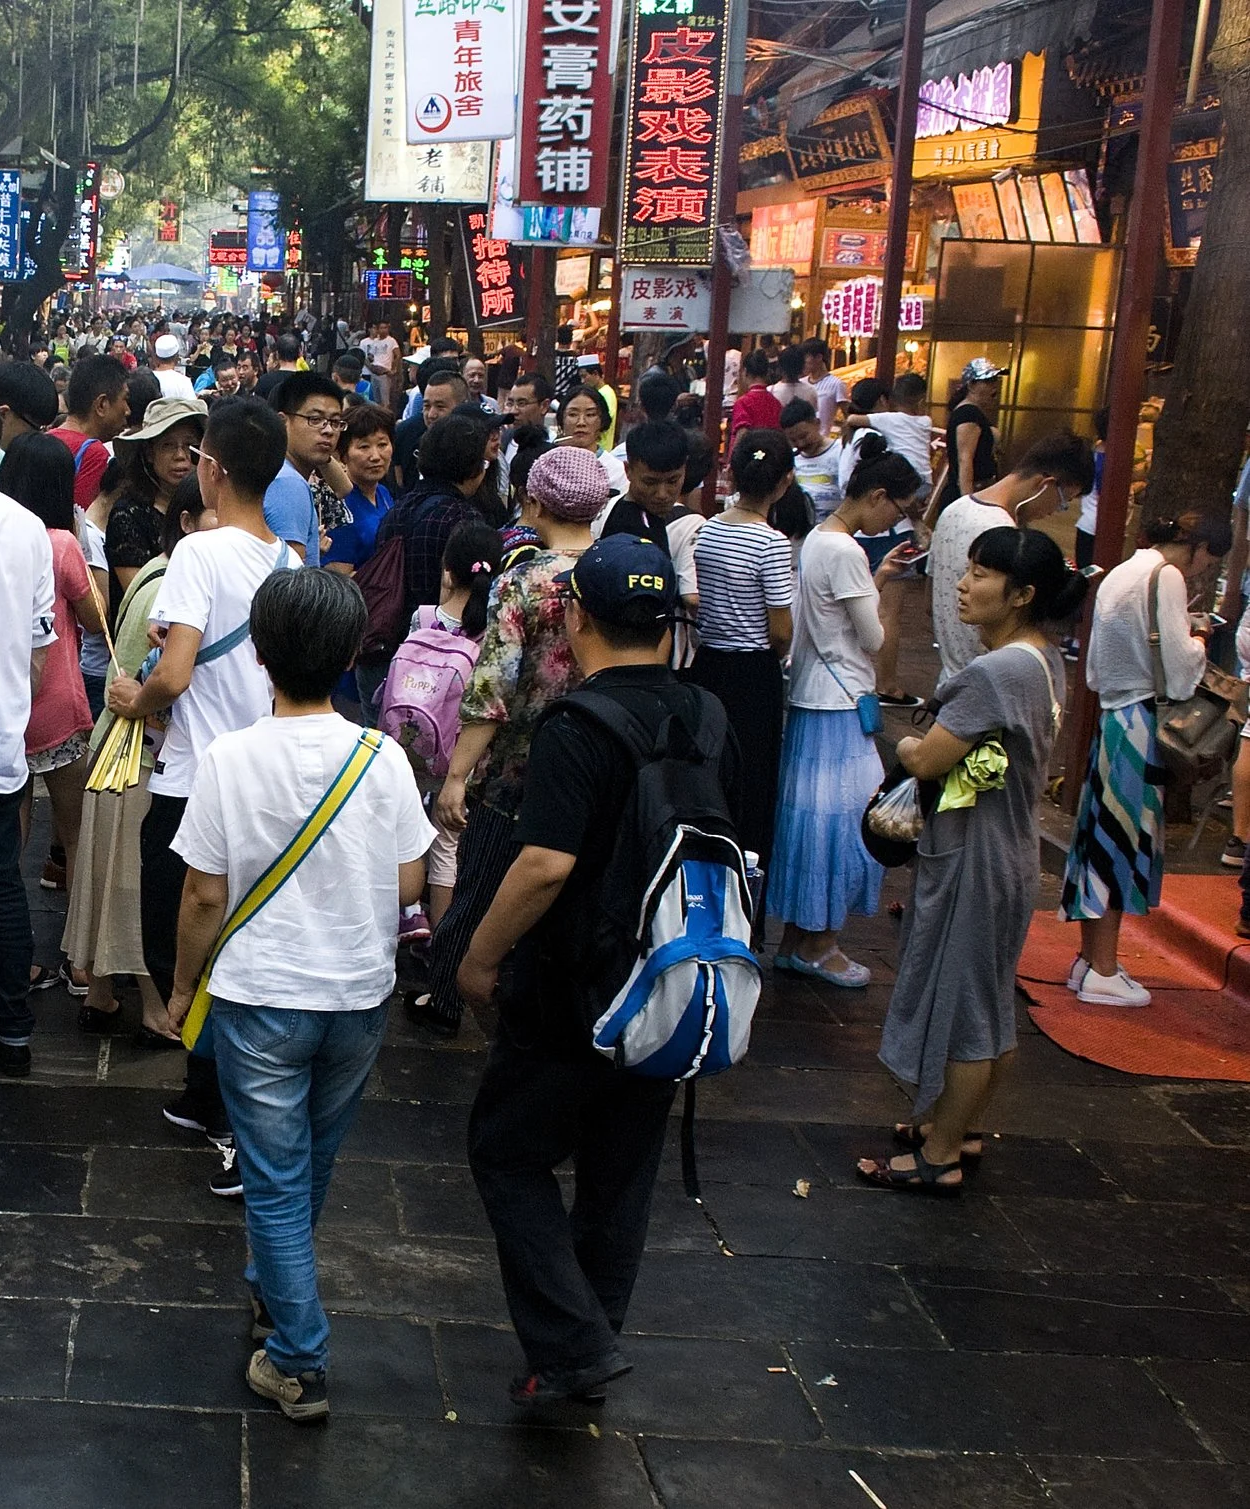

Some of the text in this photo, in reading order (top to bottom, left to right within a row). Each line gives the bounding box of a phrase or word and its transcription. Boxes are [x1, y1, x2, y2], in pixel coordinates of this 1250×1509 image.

[453, 20, 484, 117] 青年旅舍
[633, 27, 717, 224] 皮影戏表演
[472, 233, 515, 317] 招待所
[631, 277, 698, 300] 皮影戏
[643, 306, 684, 320] 表演
[628, 574, 664, 591] FCB
